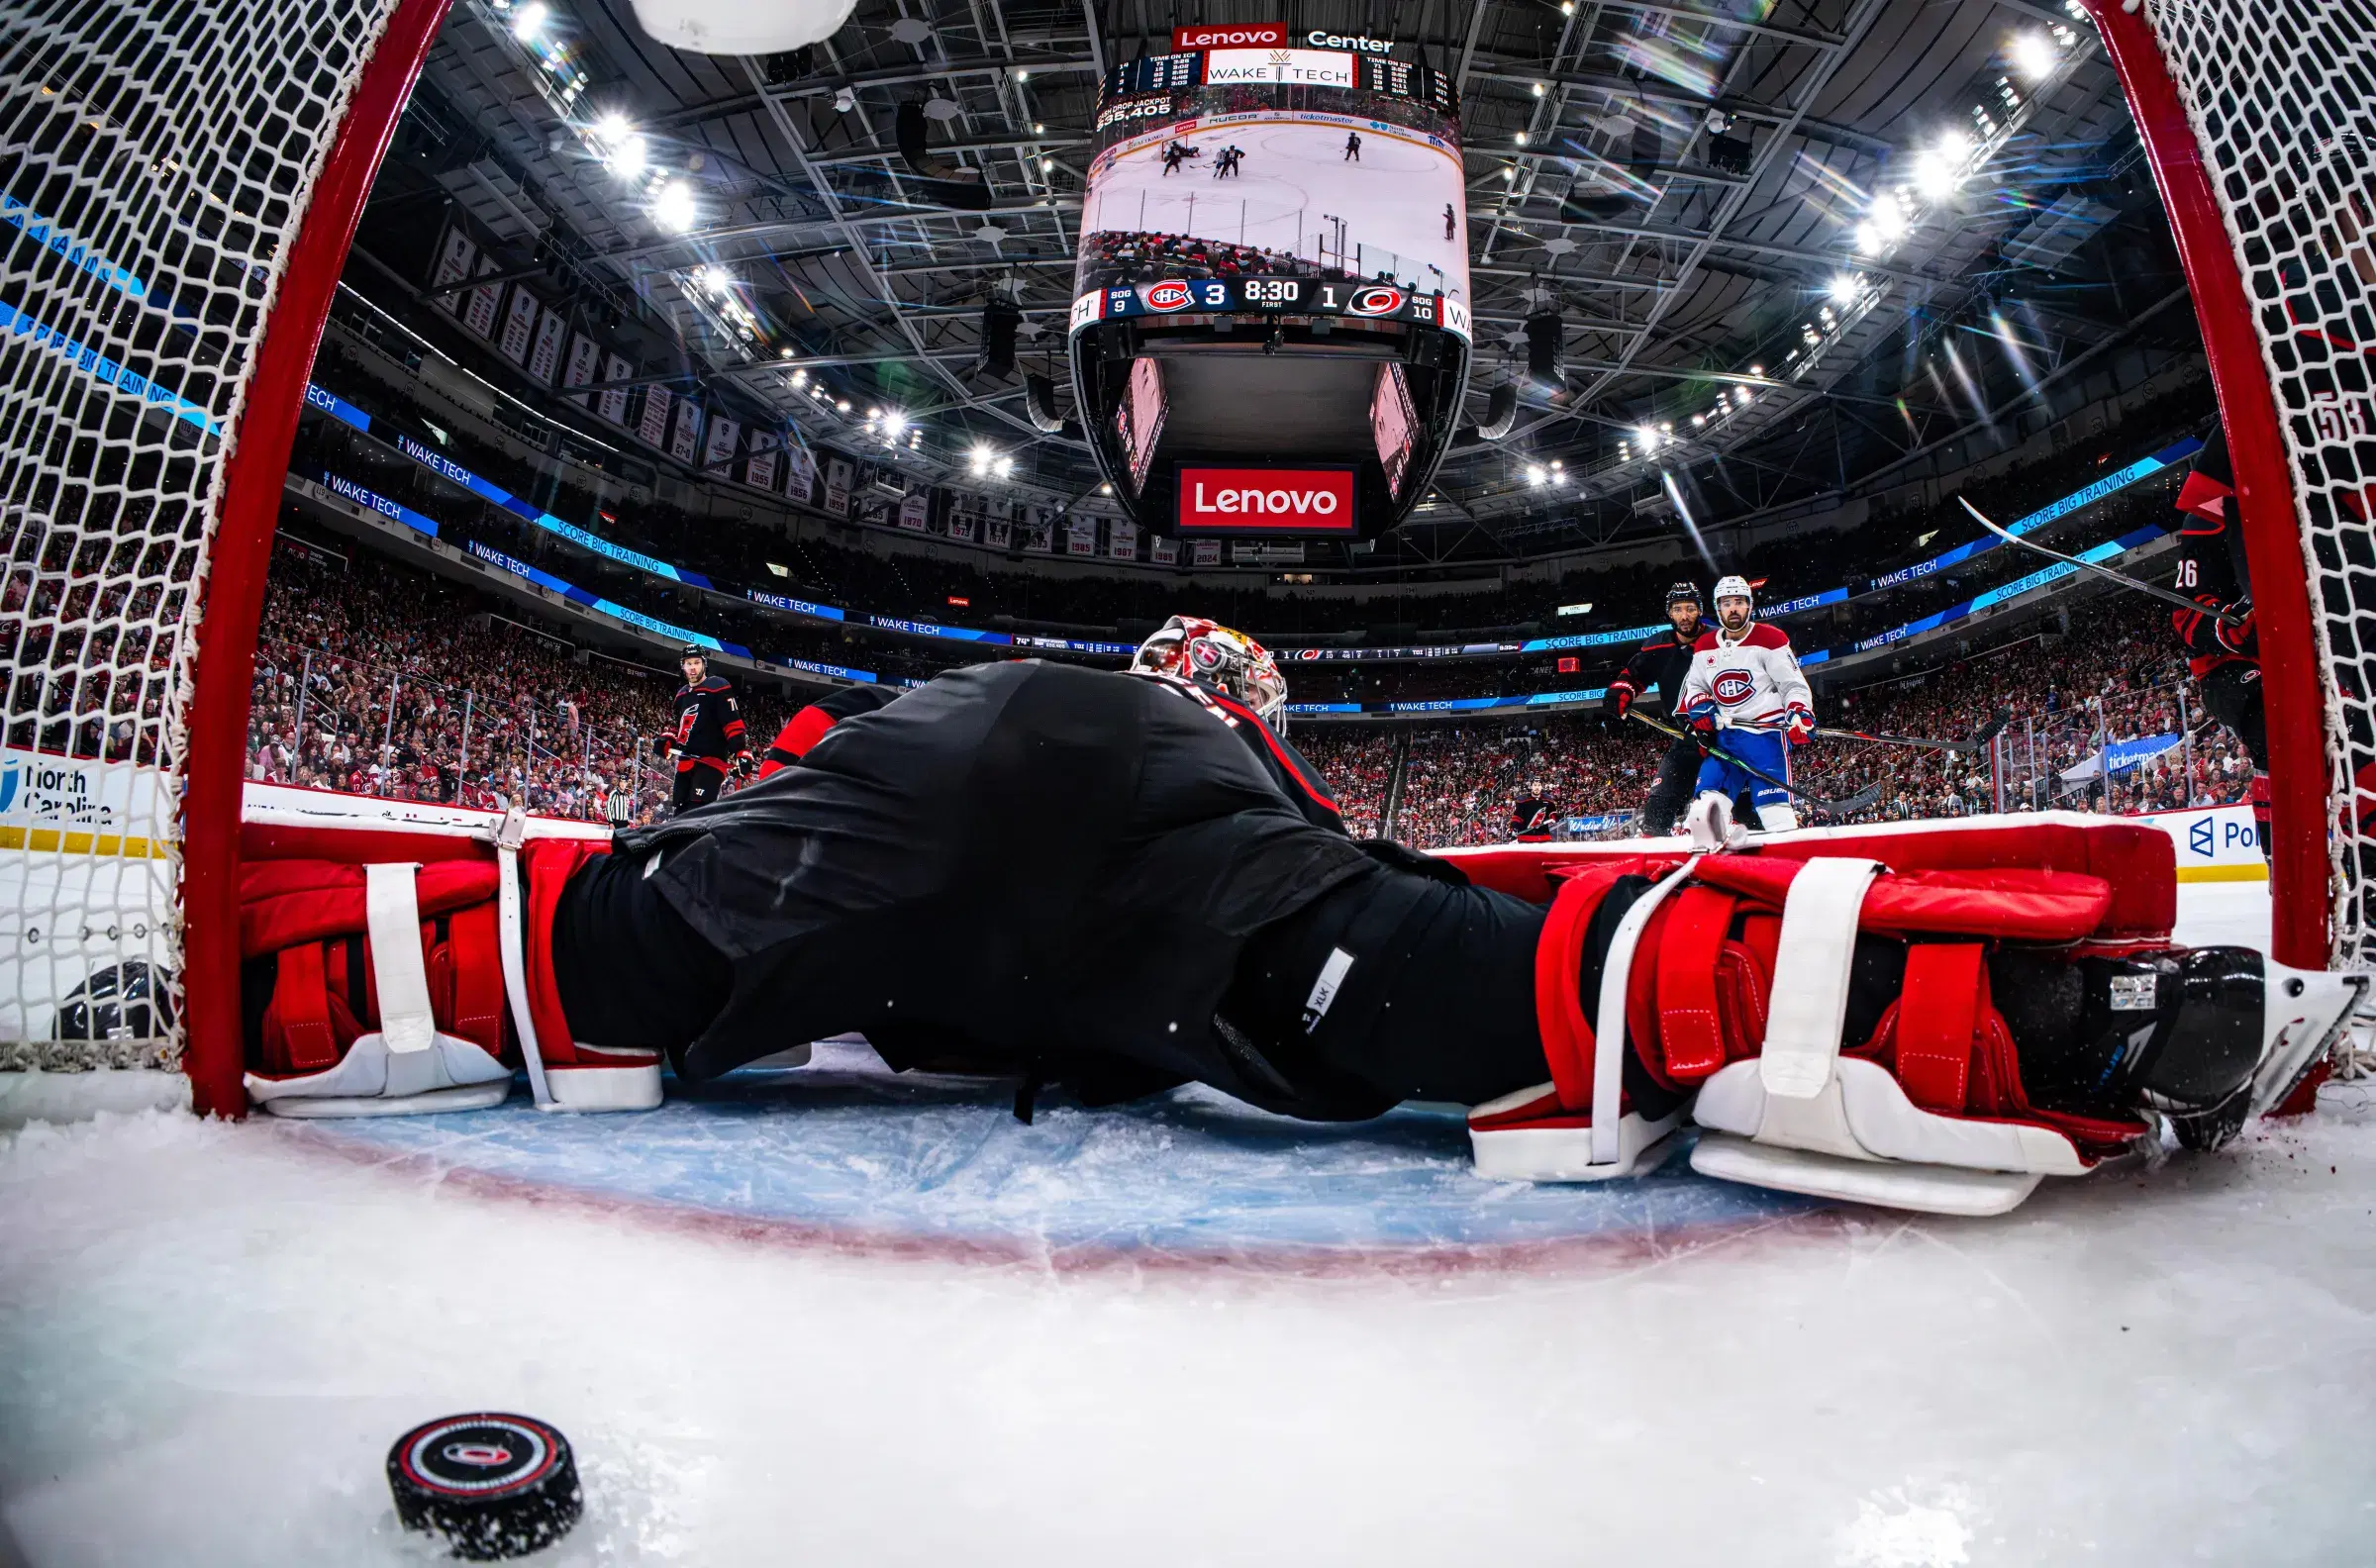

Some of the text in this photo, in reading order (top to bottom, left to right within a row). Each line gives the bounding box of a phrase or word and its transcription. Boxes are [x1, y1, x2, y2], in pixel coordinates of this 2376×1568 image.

[1181, 31, 1278, 47] Lenovo
[1308, 31, 1394, 53] Center
[1210, 67, 1267, 79] WAKE
[1292, 68, 1348, 82] TECH
[1436, 87, 1447, 97] HIT
[1113, 101, 1133, 114] DROP
[1134, 97, 1171, 108] JACKPOT
[1300, 114, 1354, 125] ticketmaster
[1111, 289, 1132, 299] SOG
[1206, 284, 1225, 304] 3
[1244, 280, 1299, 302] 8:30
[1323, 286, 1337, 309] 1
[1412, 295, 1433, 306] SOG
[1114, 300, 1125, 312] 9
[1414, 305, 1433, 320] 10
[405, 439, 472, 486] WAKE TECH
[750, 472, 769, 486] 1955
[332, 475, 401, 520] WAKE TECH
[1195, 482, 1337, 515] Lenovo
[2022, 466, 2135, 533] SCORE BIG TRAINING
[557, 521, 659, 572] SCORE BIG TRAINING
[475, 542, 530, 578] WAKE TECH
[1196, 554, 1218, 563] 2024
[1878, 560, 1937, 587] WAKE TECH
[2175, 559, 2197, 589] 26
[1996, 581, 2025, 601] SCORE
[2026, 575, 2041, 587] BIG
[753, 591, 816, 614] WAKE TECH
[1758, 596, 1819, 618] WAKE TECH
[620, 608, 695, 642] SCORE BIG TRAINING
[877, 617, 940, 636] WAKE TECH
[1545, 627, 1659, 649] SCORE BIG TRAINING
[1861, 628, 1907, 650] WAKE TECH
[1284, 650, 1290, 659] 1
[794, 658, 846, 677] WAKE TECH
[727, 697, 739, 712] 71
[1428, 701, 1452, 710] TECH
[1558, 692, 1586, 701] SCORE
[1314, 987, 1330, 1008] XLK
